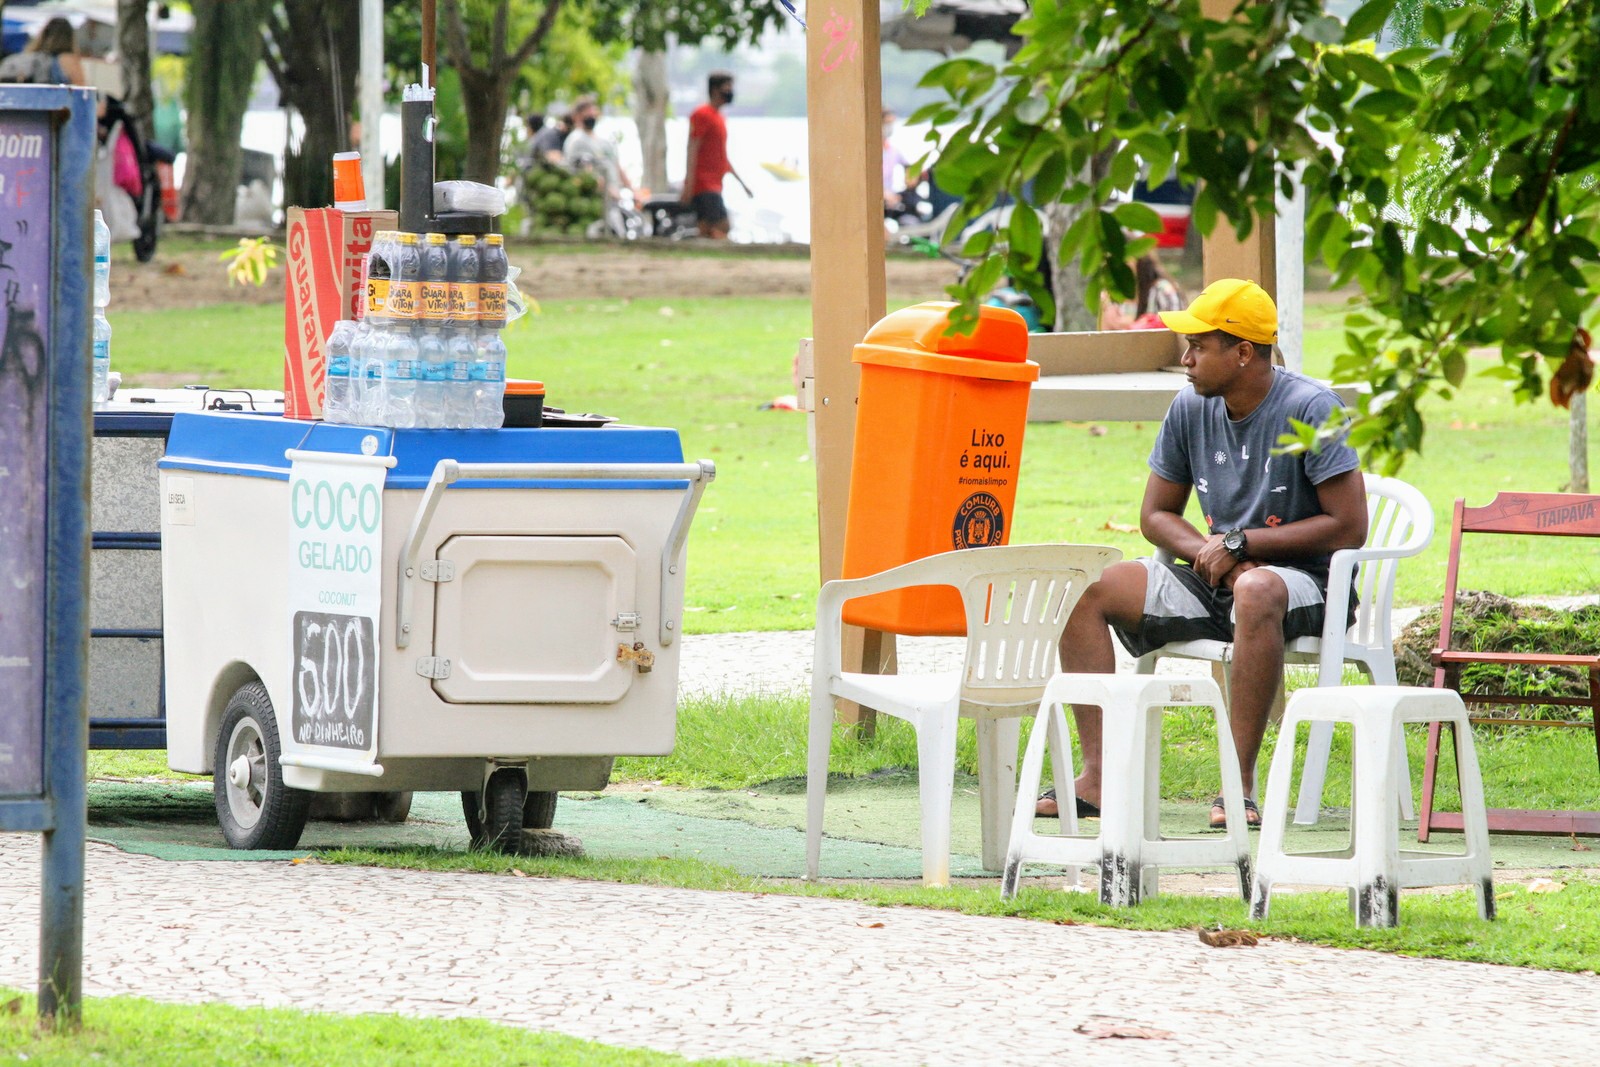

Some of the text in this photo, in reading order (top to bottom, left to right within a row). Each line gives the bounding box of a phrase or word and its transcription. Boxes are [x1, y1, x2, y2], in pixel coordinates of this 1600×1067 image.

[971, 428, 1005, 447] Lixo
[960, 449, 1011, 473] é aqui.
[958, 476, 1008, 487] #riomaislimpo
[291, 478, 381, 534] COCO
[960, 495, 1000, 516] COMLURB
[1536, 502, 1594, 529] ITAIPAVA
[298, 540, 372, 574] GELADO
[318, 590, 357, 606] COCONUT
[299, 721, 364, 746] NO DINHEIRO
